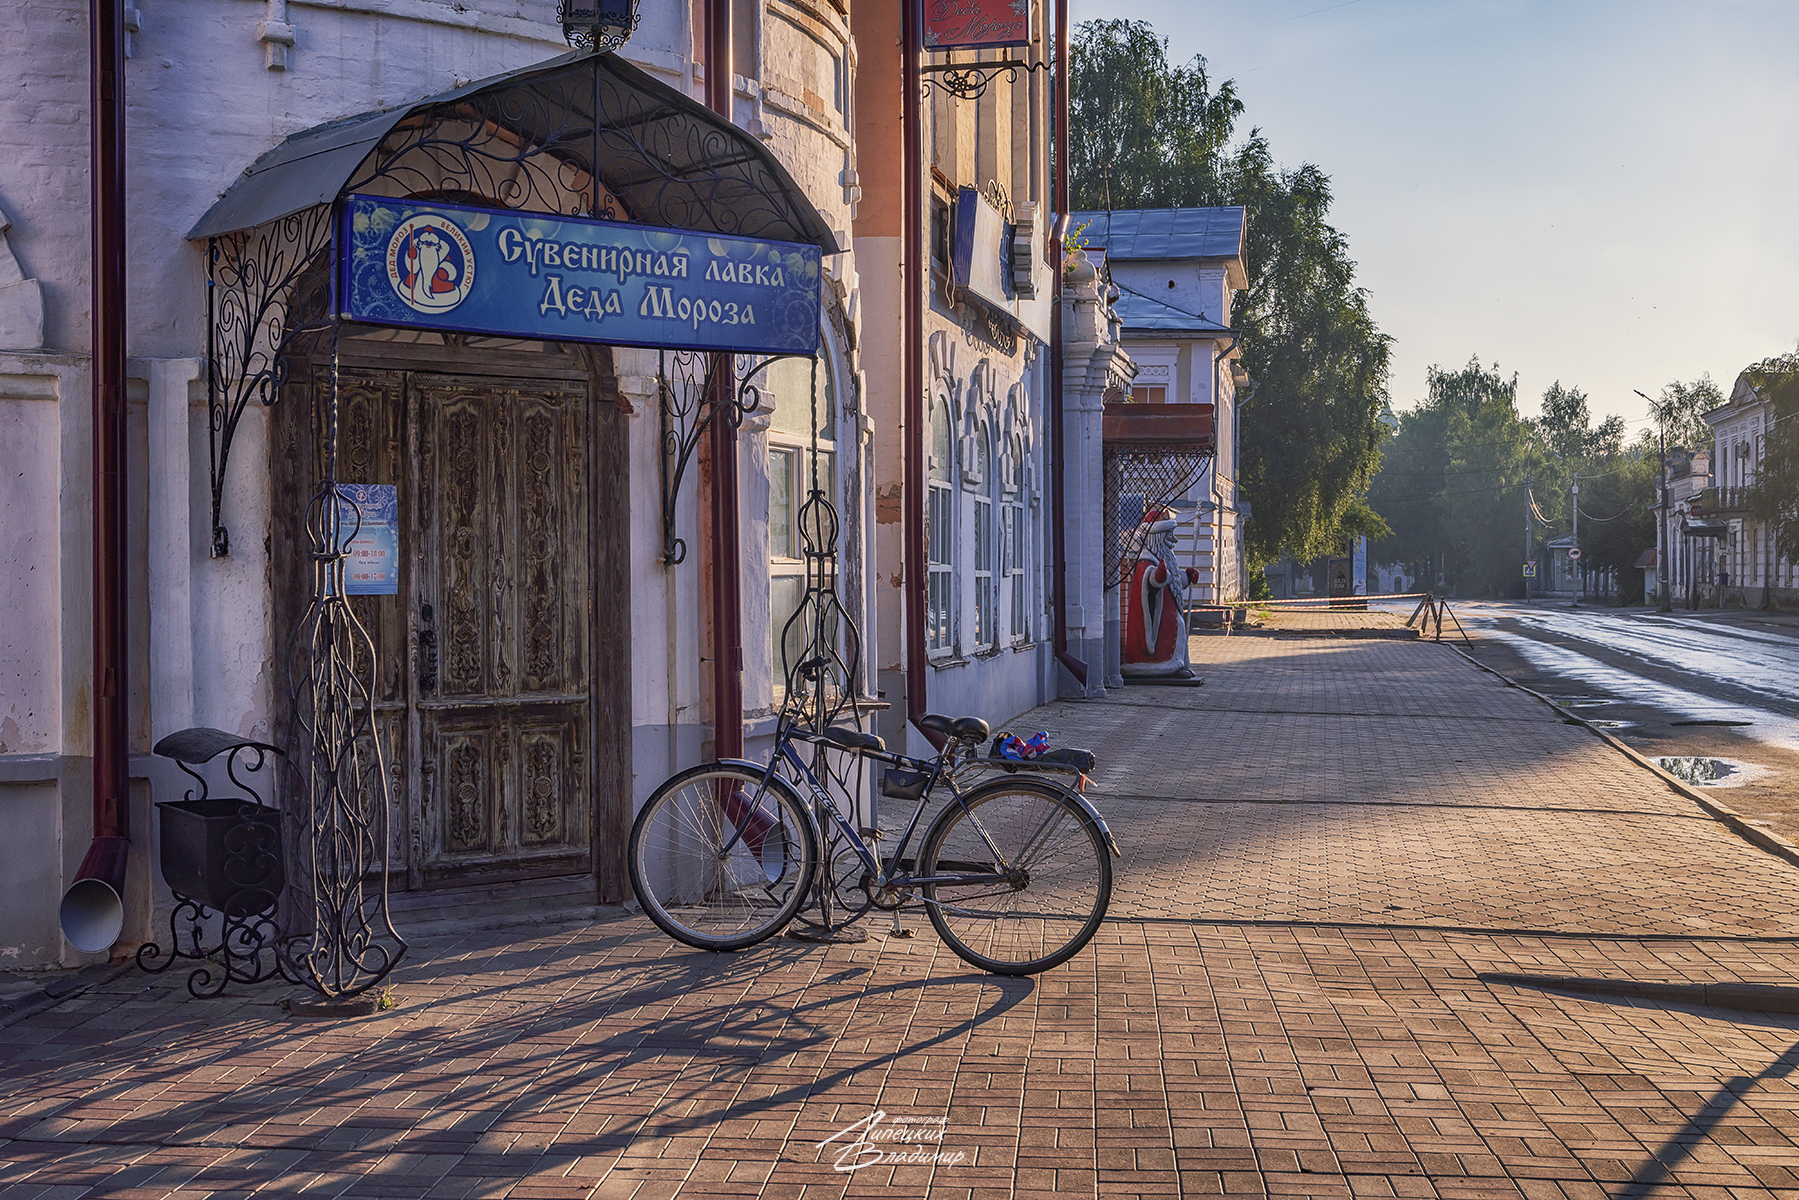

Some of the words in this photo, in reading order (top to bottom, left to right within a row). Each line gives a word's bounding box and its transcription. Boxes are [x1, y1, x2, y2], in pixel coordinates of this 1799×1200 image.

[944, 14, 1024, 41] Мороза
[389, 227, 409, 258] МОРОЗ
[440, 221, 472, 256] ВЕЛИКИЙ
[464, 258, 474, 290] УСТЮГ
[498, 228, 688, 283] Сувенирная
[705, 257, 785, 288] лавка
[389, 259, 399, 279] ДЕД
[540, 276, 622, 321] Деда
[640, 285, 756, 330] Мороза
